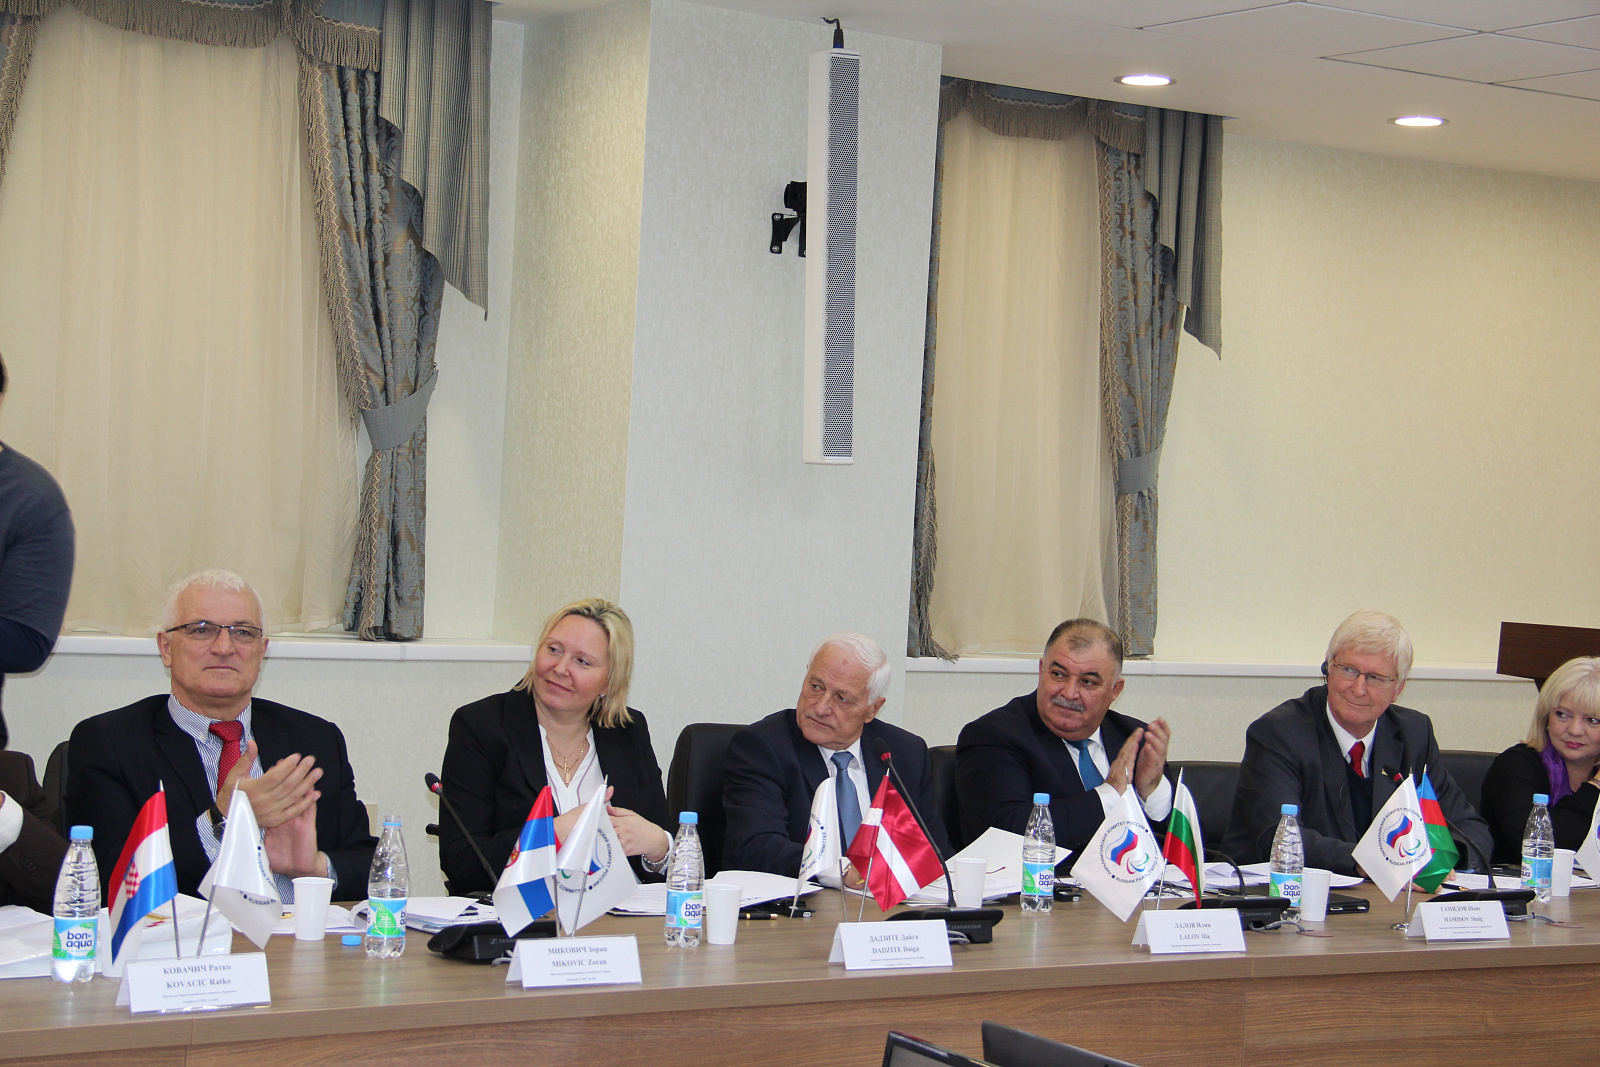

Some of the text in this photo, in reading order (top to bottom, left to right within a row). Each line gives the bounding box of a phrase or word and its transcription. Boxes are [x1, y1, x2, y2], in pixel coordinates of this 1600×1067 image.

[868, 934, 900, 942] ДАДЗИТЕ
[65, 940, 92, 949] aqua
[548, 945, 608, 954] МИКОВИЧ Зоран
[872, 945, 920, 954] DADZITE Daiga
[552, 959, 586, 967] MIKOVIC
[163, 965, 207, 975] КОВАЧИЧ
[166, 978, 232, 989] KOVACIC Ratko
